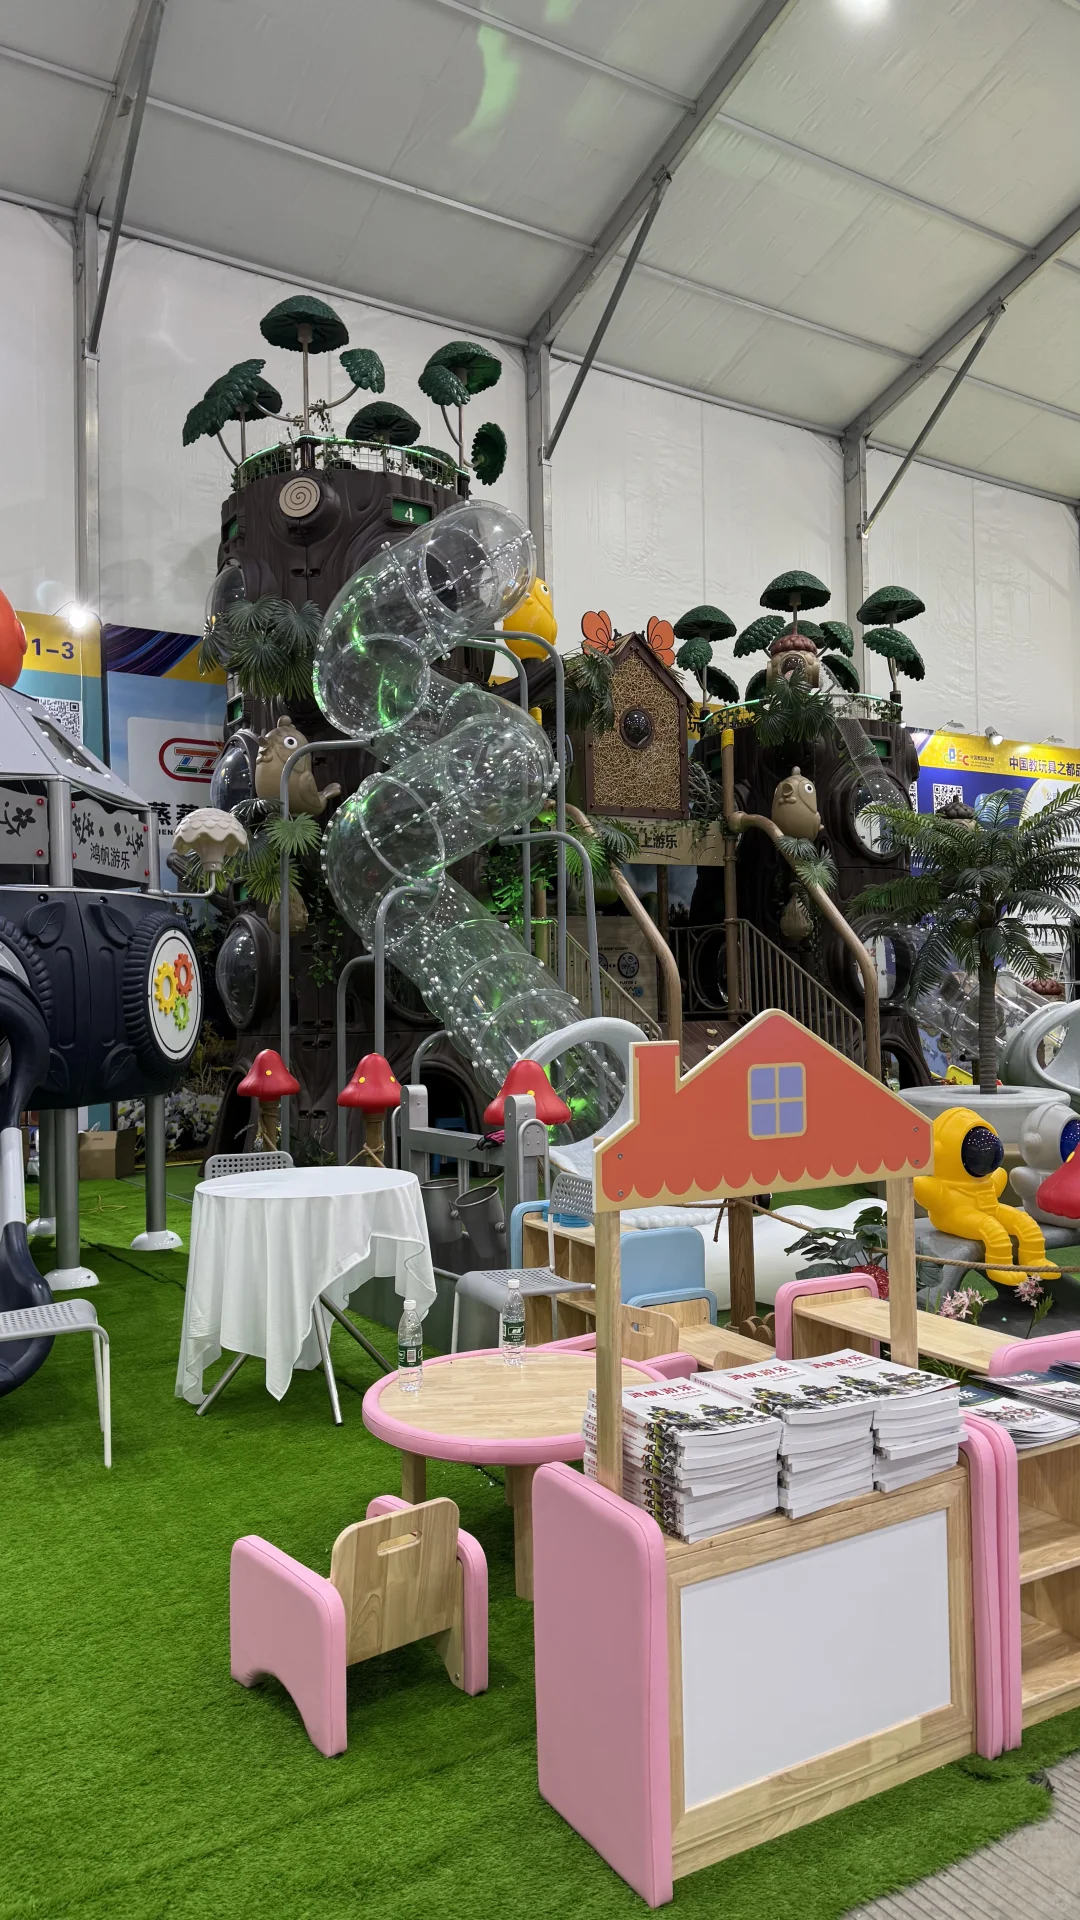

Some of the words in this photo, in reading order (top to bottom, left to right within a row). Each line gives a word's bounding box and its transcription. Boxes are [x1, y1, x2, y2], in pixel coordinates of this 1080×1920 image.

[404, 507, 415, 522] 4
[90, 842, 130, 870] 鸿帆游乐
